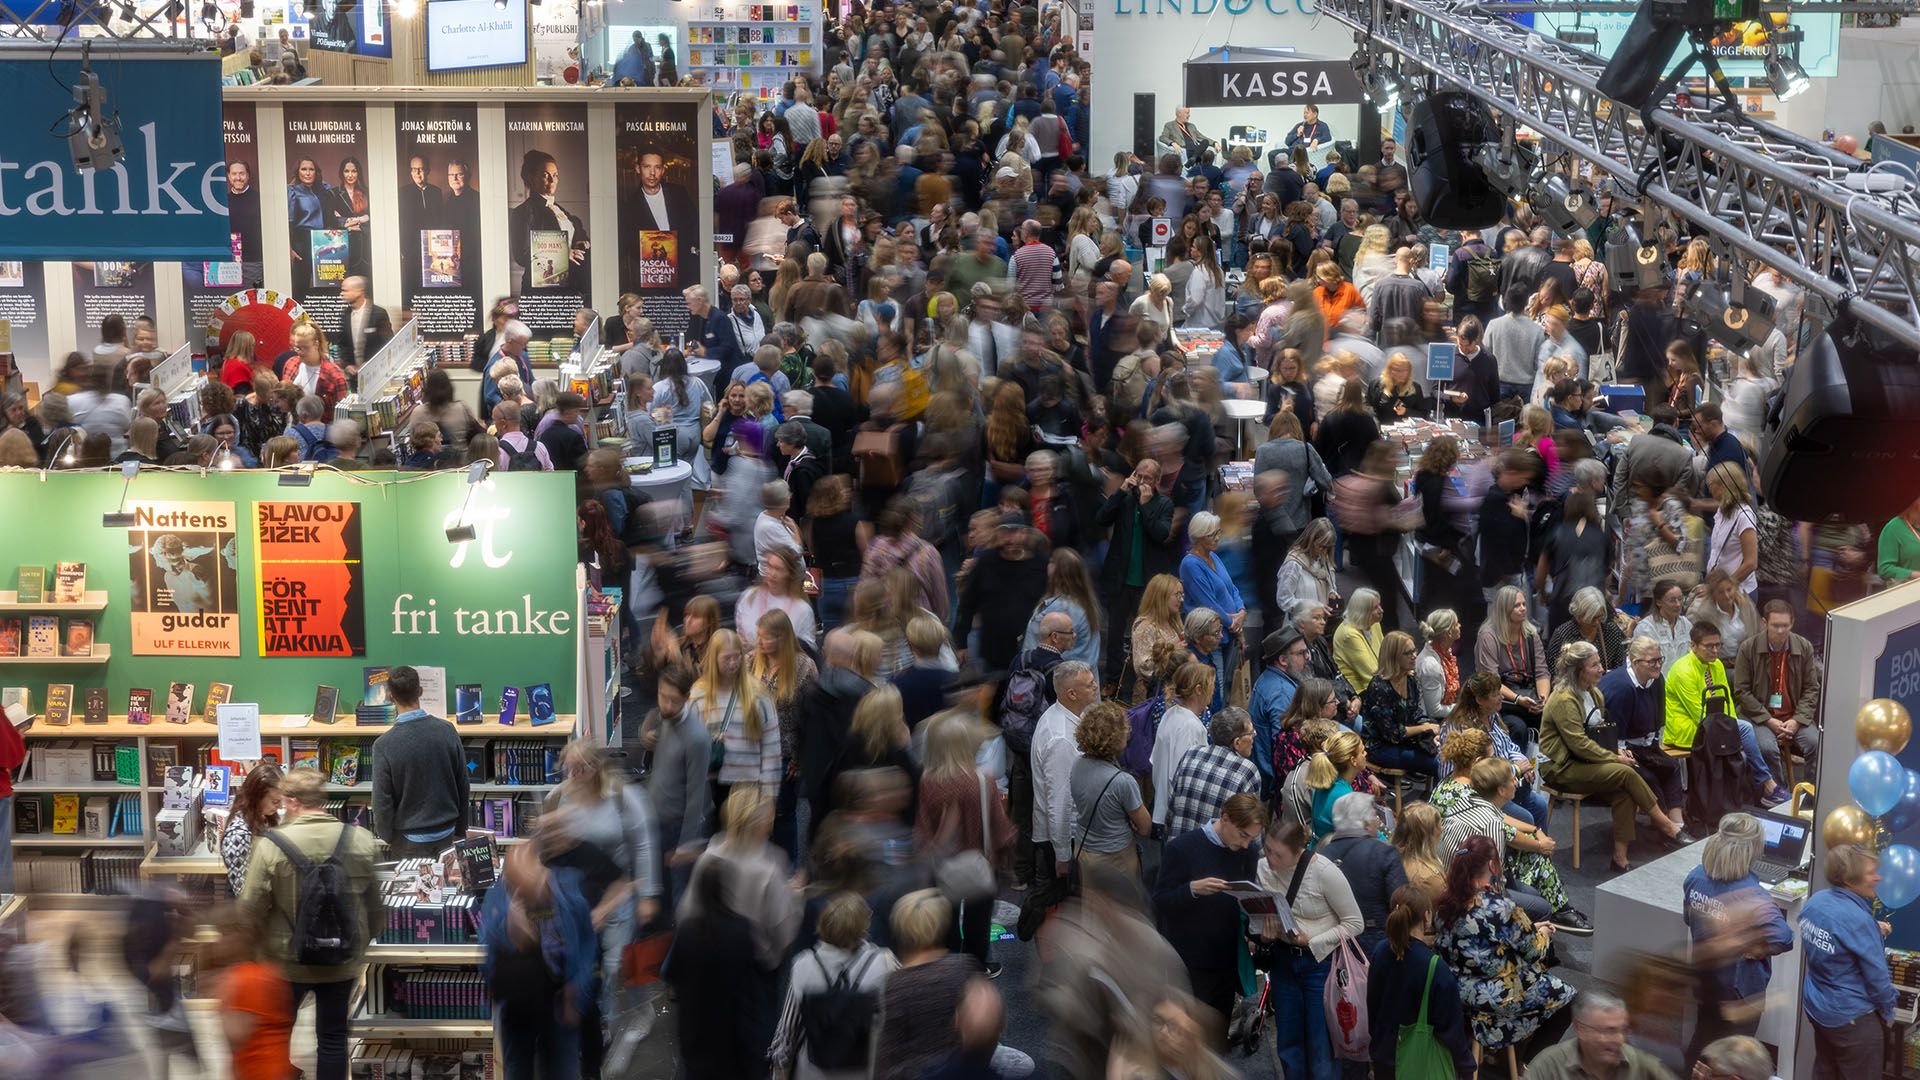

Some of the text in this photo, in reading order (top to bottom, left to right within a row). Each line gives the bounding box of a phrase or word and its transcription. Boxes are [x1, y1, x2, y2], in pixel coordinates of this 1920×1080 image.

[441, 23, 477, 34] Charlotte
[1743, 45, 1786, 56] EKLUD
[1222, 71, 1333, 98] KASSA
[238, 121, 244, 131] &
[289, 121, 361, 131] LENA LJUNGDAHL &
[401, 119, 472, 132] JONAS MOSTRÖM &
[508, 122, 585, 132] KATARINA WENNSTAM
[626, 122, 687, 132] PASCAL ENGMAN
[296, 134, 356, 144] ANNA JINGHEDE
[416, 133, 457, 144] ARNE DAHL
[640, 260, 670, 268] PASCAL
[640, 267, 675, 275] ENGMAN
[640, 274, 672, 283] INGEN
[135, 506, 228, 528] Nattens
[258, 504, 344, 523] SLAVOJ
[259, 522, 321, 543] ŽIŽEK
[262, 577, 307, 598] FÖR
[263, 599, 321, 616] SENT
[391, 593, 571, 635] fri tanke
[162, 608, 231, 632] gudar
[264, 617, 307, 634] ATT
[153, 640, 231, 650] ULF ELLERVIK
[265, 635, 344, 652] VAKNA
